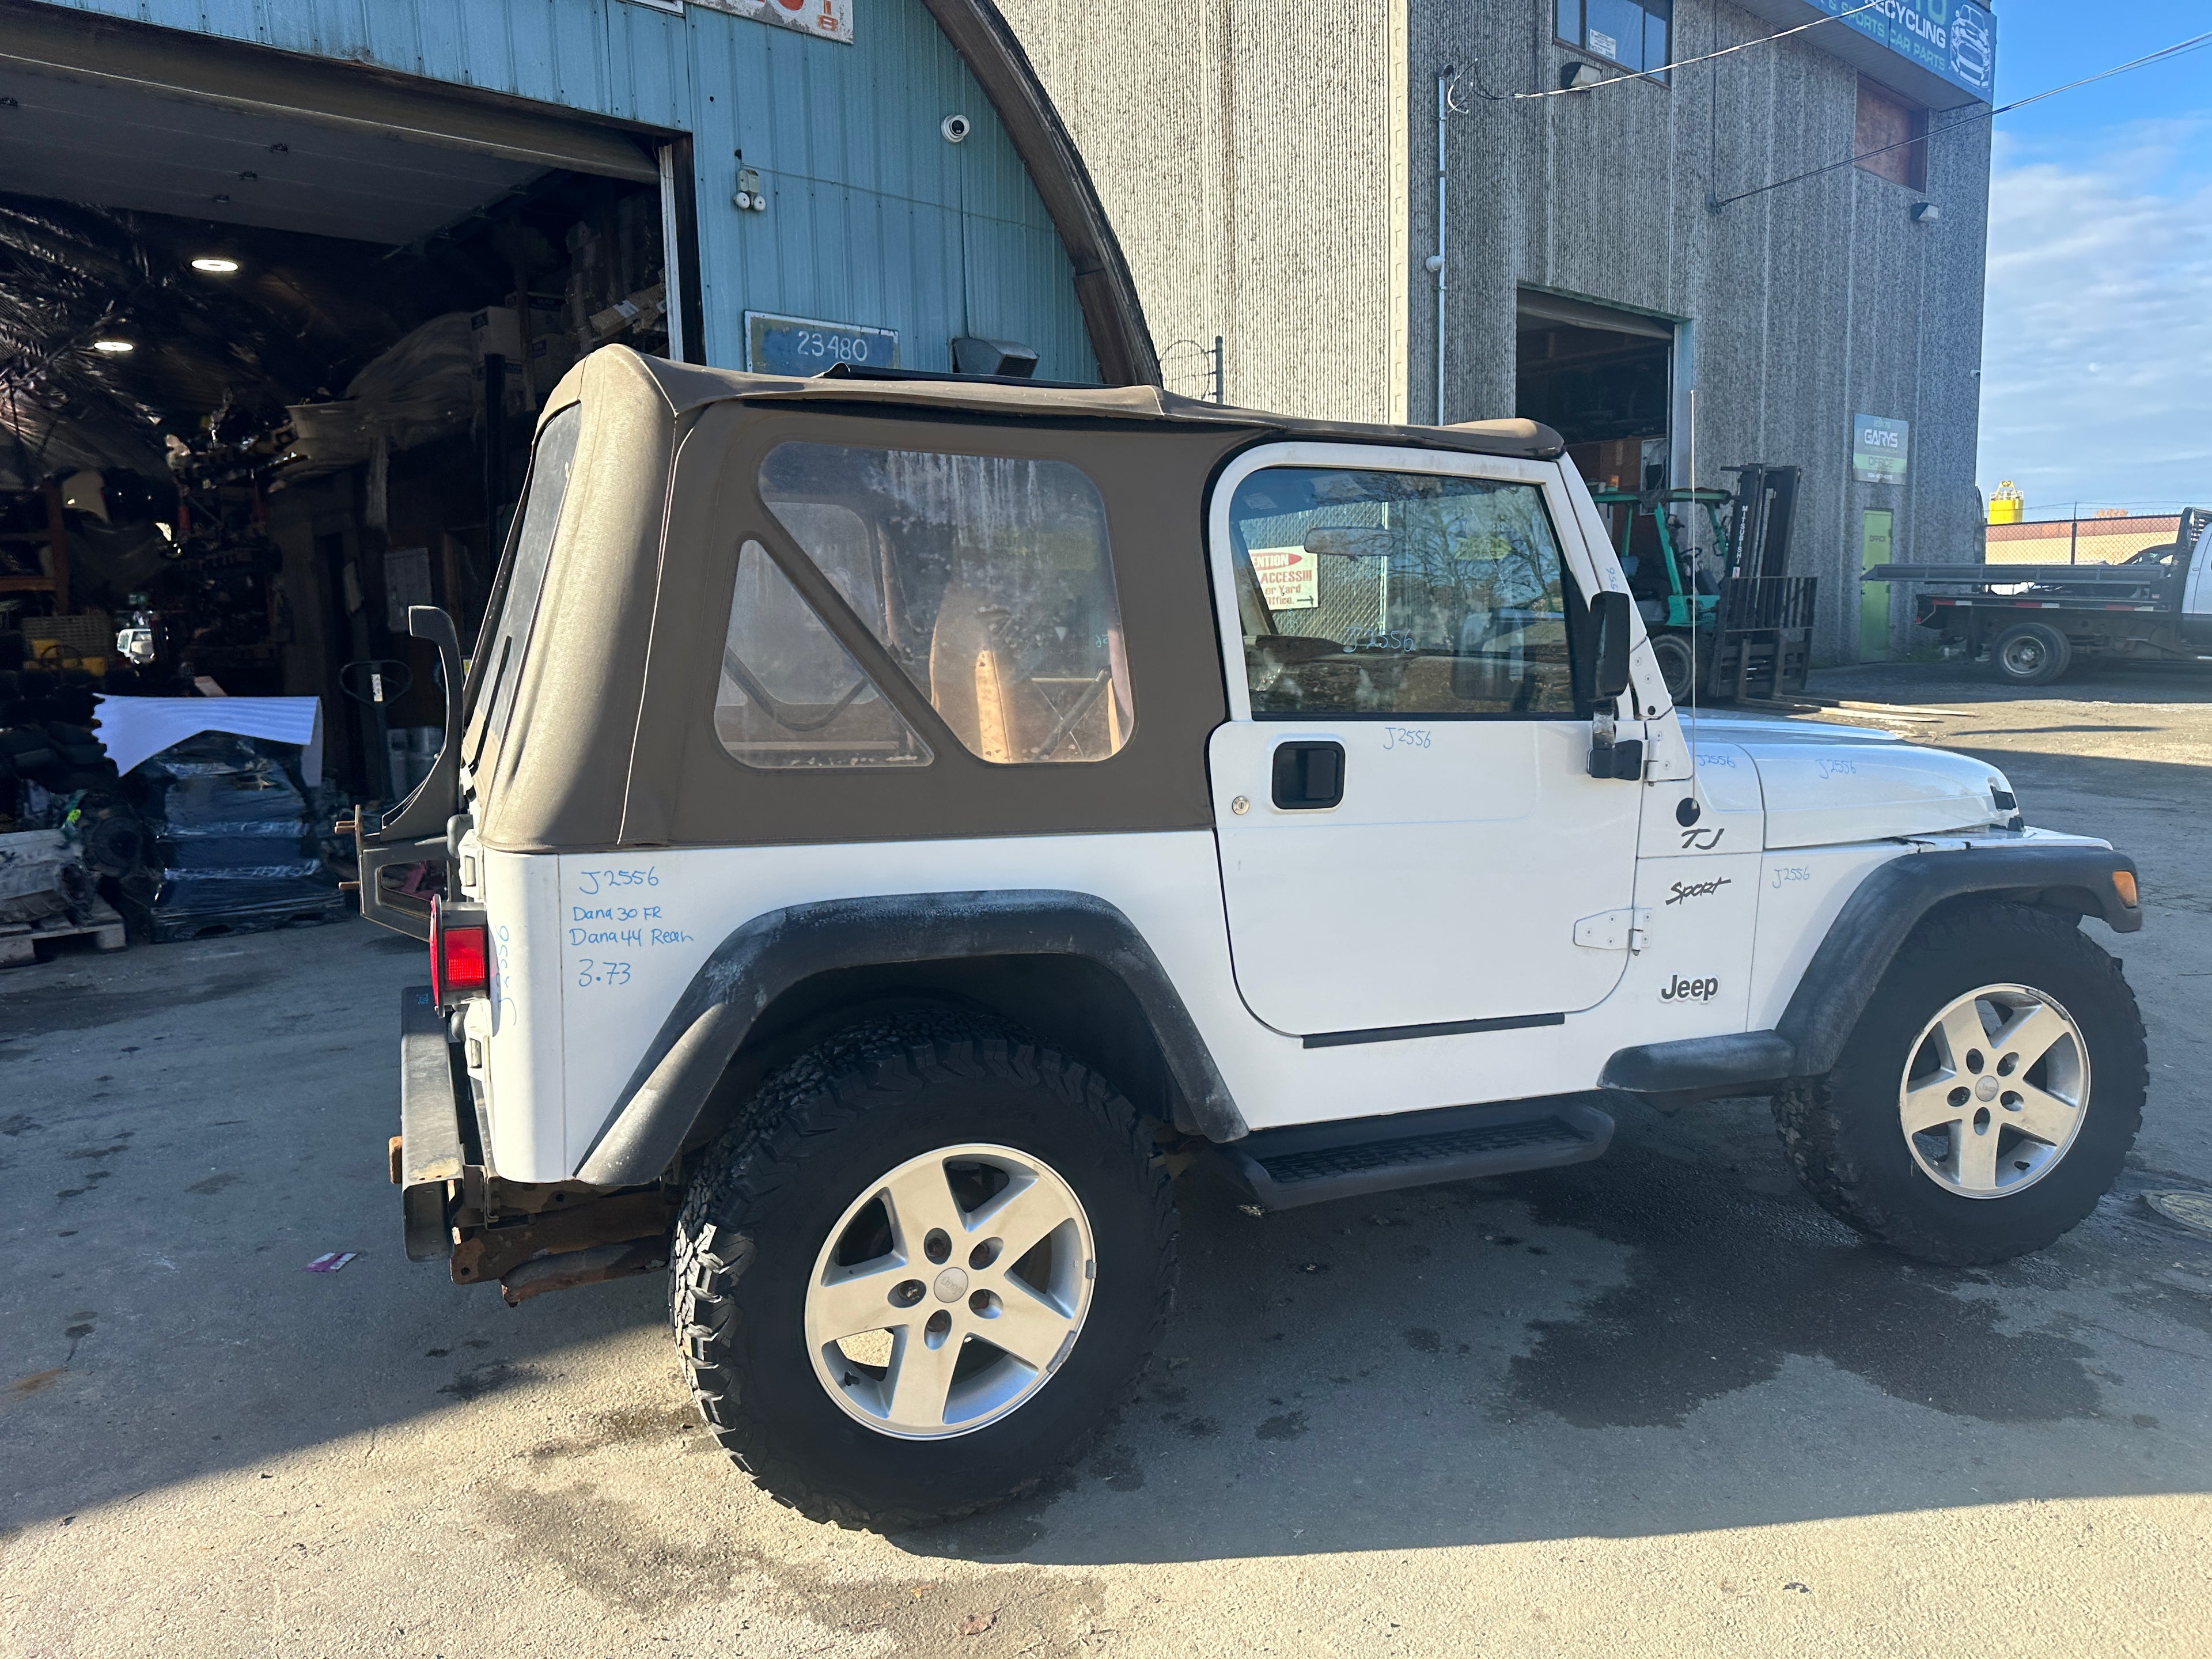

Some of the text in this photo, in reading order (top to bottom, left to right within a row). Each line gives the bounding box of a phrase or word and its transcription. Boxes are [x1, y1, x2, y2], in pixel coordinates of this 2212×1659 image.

[1890, 28, 1910, 52] CAR
[1913, 43, 1945, 71] PARTS
[797, 331, 868, 362] 23480
[1864, 429, 1898, 448] GARYS
[1736, 505, 1748, 565] MITSUBISHI
[1278, 584, 1301, 595] Yard
[1606, 567, 1618, 591] 556
[1343, 627, 1414, 653] J2556
[1383, 727, 1431, 750] J2556
[1695, 755, 1736, 768] J2556
[1816, 759, 1857, 779] J2556
[1681, 828, 1725, 850] TJ
[579, 866, 659, 895] J2556
[1772, 865, 1810, 889] J2556
[617, 907, 638, 921] 30
[643, 906, 662, 921] FR
[569, 928, 618, 946] Dana
[621, 929, 642, 946] 44
[578, 959, 631, 987] 3.73
[1661, 974, 1718, 1001] Jeep
